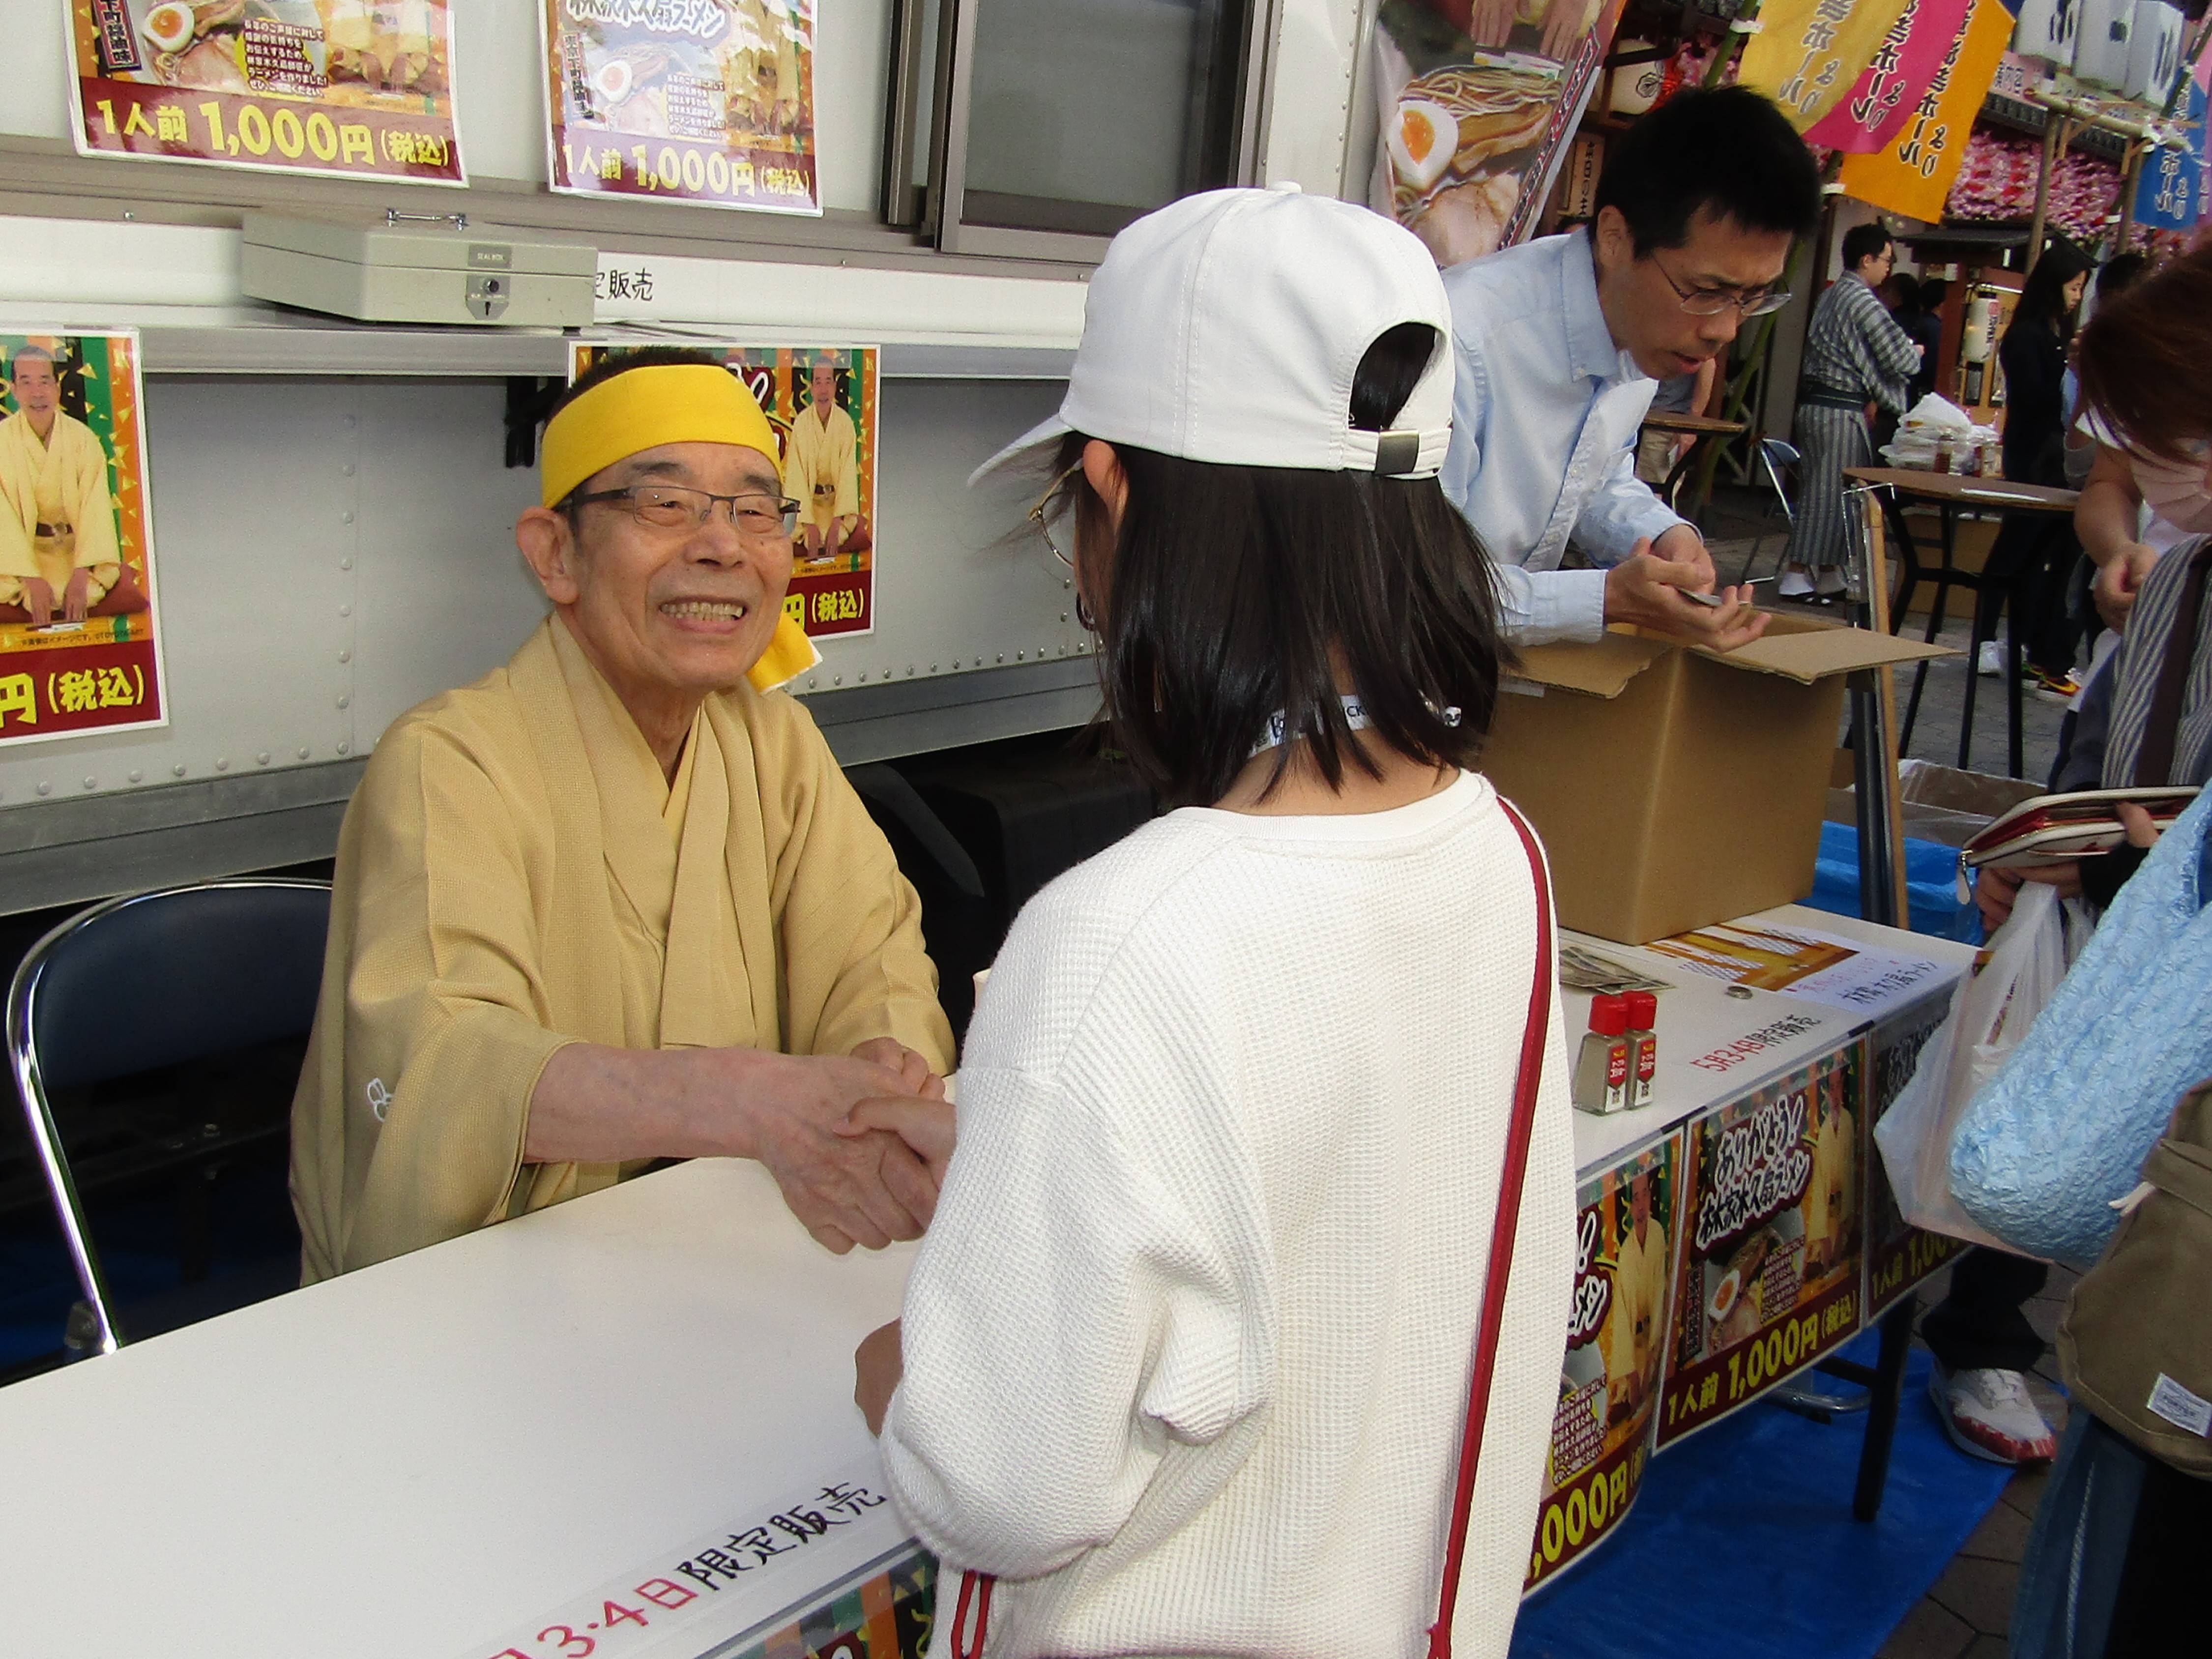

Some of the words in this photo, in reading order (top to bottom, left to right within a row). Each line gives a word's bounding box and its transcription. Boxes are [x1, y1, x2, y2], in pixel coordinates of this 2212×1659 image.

[96, 99, 188, 144] 1人前
[200, 101, 376, 165] 1,000円
[380, 128, 449, 168] (税込)
[563, 144, 622, 181] 1人前
[631, 145, 756, 197] 1,000円
[760, 169, 810, 197] (税込)
[812, 588, 864, 623] (税込)
[48, 664, 145, 714] (税込)
[1668, 1371, 1719, 1425] 1人前
[1728, 1312, 1818, 1400] 1,000円
[1527, 1460, 1627, 1579] ,000円
[488, 1482, 887, 1659] 3・4日限定販売
